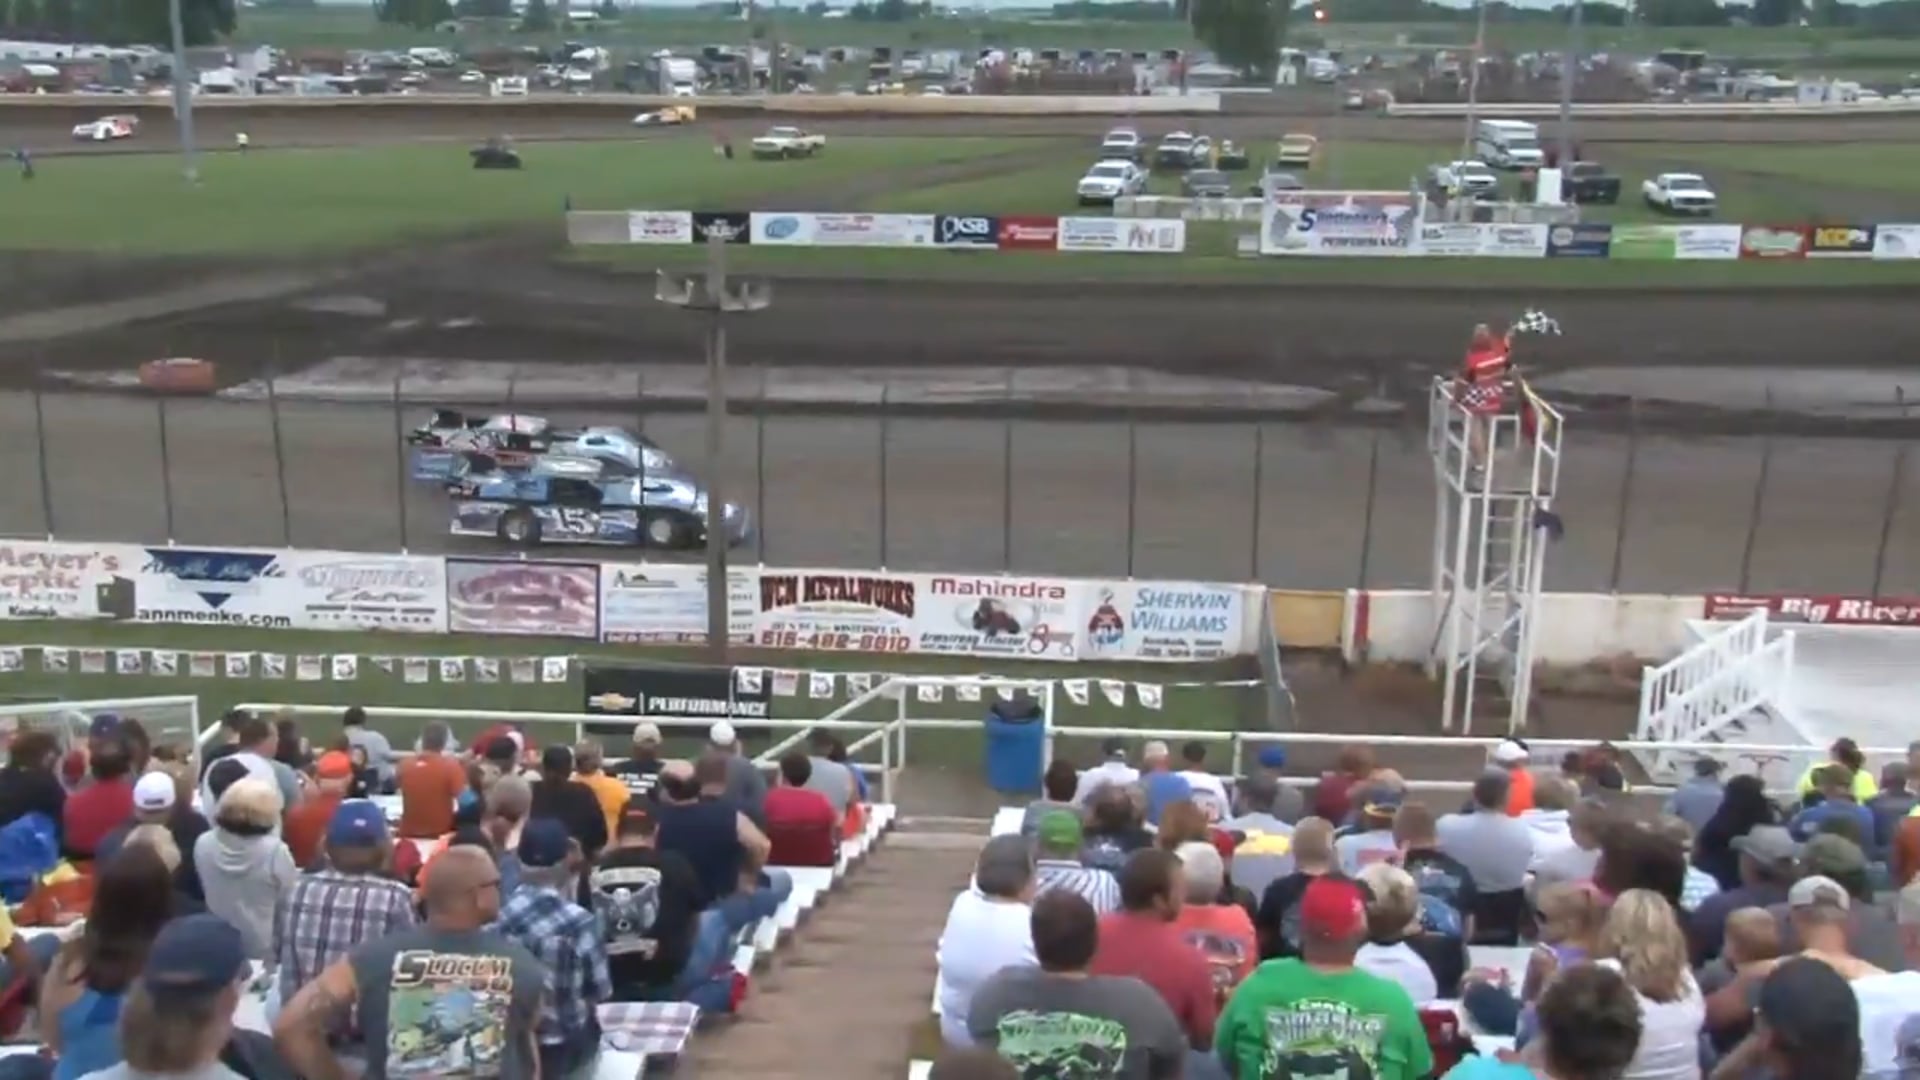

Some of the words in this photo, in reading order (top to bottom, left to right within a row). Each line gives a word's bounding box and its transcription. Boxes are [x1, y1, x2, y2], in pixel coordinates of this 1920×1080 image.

[802, 575, 916, 619] METALWORKS
[931, 578, 1067, 599] Mahindra
[1135, 587, 1233, 610] SHERWIN
[137, 608, 292, 627] annmenke.com
[1130, 610, 1229, 633] WILLIAMS
[1780, 597, 1830, 623] Big
[1835, 598, 1920, 622] River
[648, 696, 769, 717] PERFORMANCE
